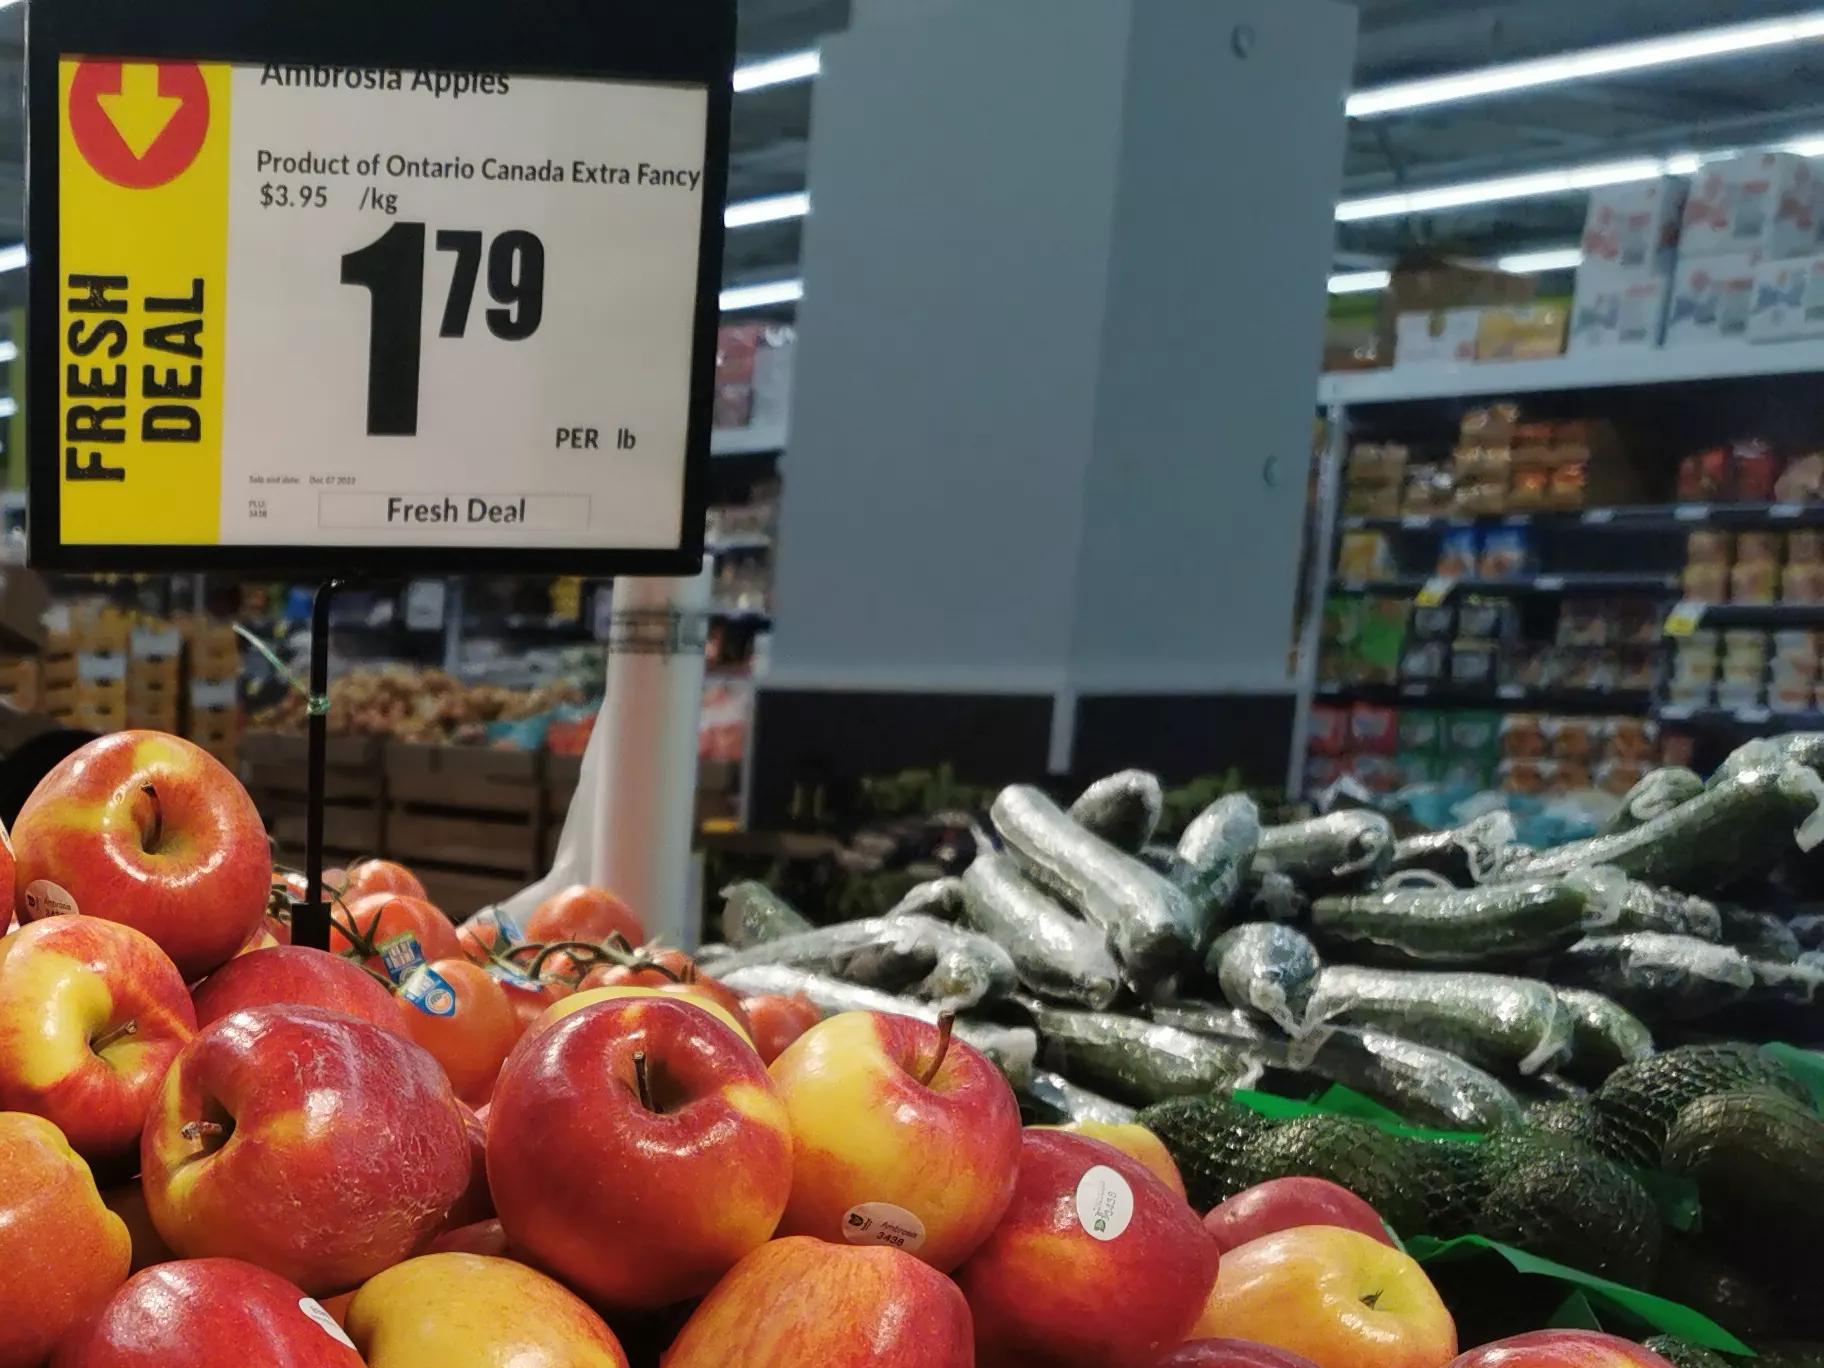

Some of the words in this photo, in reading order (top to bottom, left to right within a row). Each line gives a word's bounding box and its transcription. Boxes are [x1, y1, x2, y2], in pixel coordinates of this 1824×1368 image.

[256, 150, 350, 177] Product
[356, 153, 380, 177] of
[385, 155, 475, 180] Ontario
[481, 159, 565, 183] Canada
[571, 161, 631, 186] Extra
[637, 164, 701, 192] Fancy
[260, 183, 328, 210] $3.95
[359, 187, 398, 215] /kg
[140, 277, 205, 444] DEAL
[65, 273, 129, 483] FRESH
[555, 428, 600, 450] PER
[617, 428, 637, 450] lb
[387, 498, 459, 523] Fresh
[467, 498, 526, 524] Deal
[877, 1231, 904, 1247] 3438
[880, 1221, 917, 1239] Ambrosia
